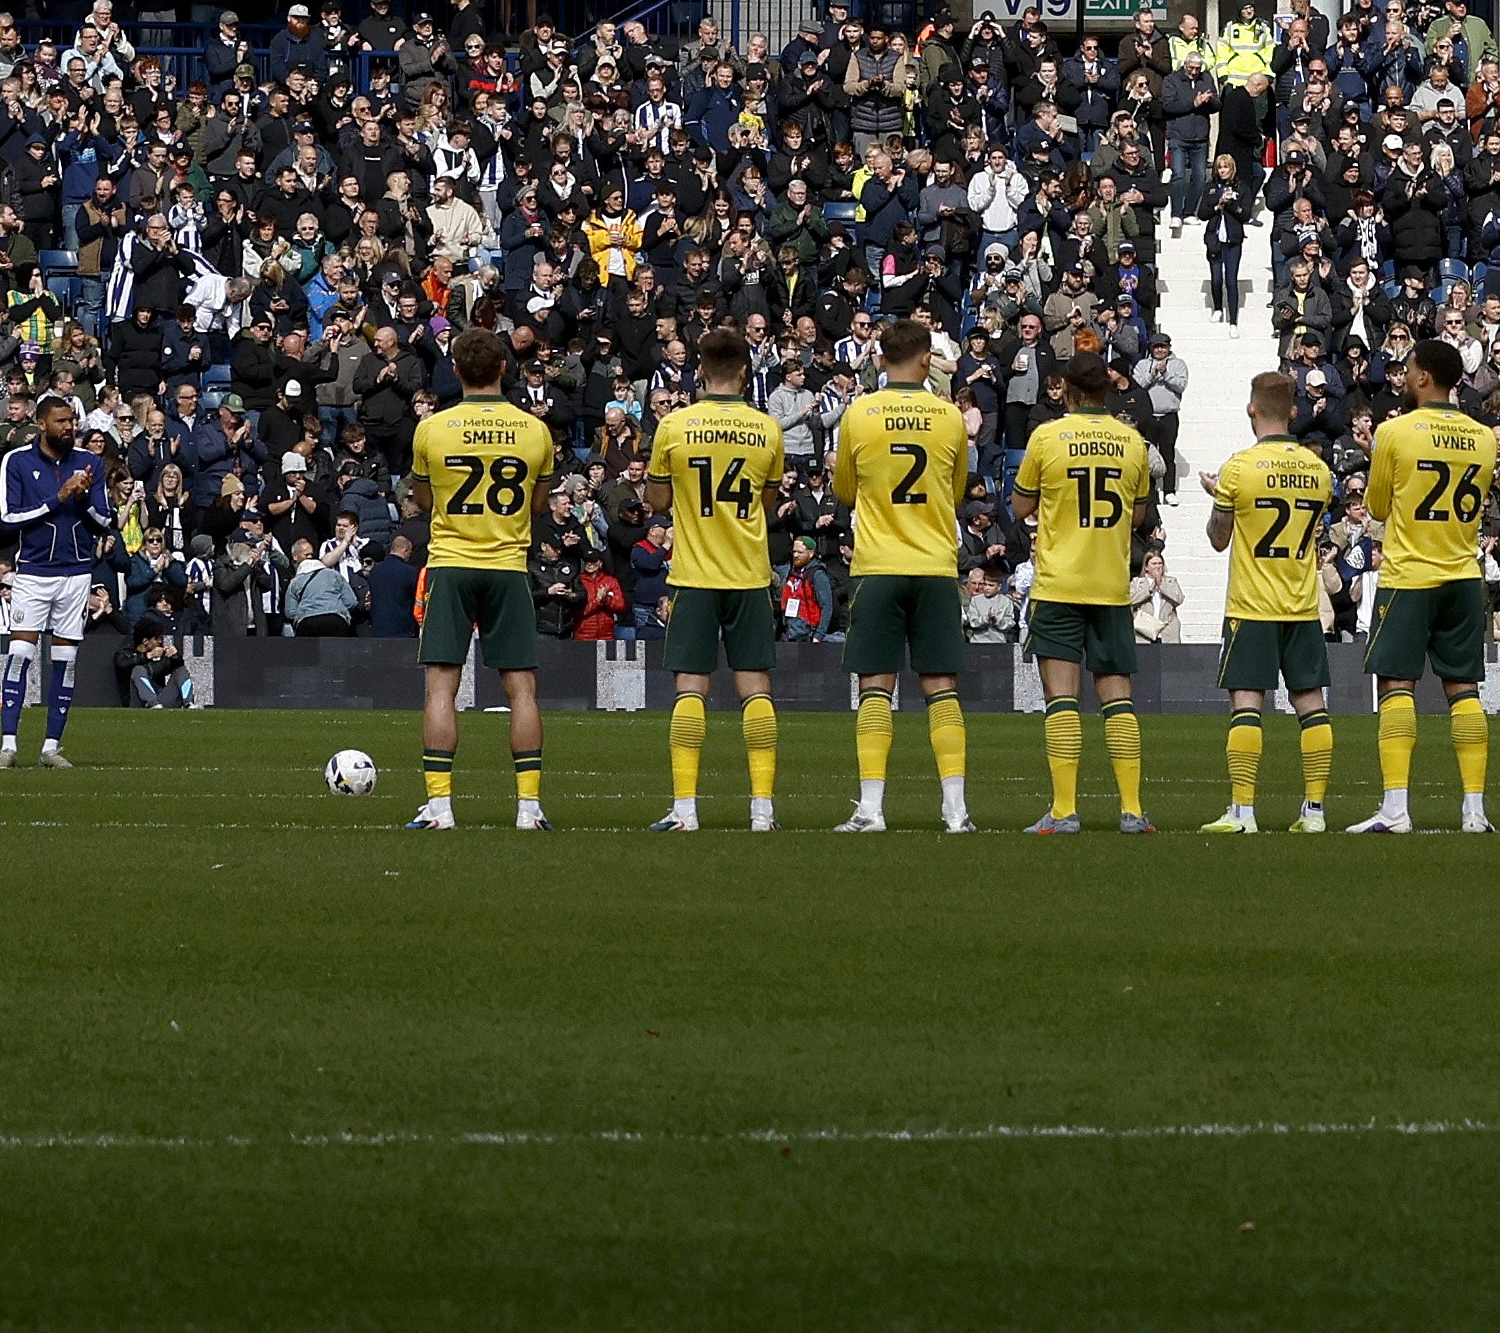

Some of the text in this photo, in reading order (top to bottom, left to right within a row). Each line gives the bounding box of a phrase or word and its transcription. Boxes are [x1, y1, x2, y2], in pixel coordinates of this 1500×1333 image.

[883, 404, 947, 416] Meta Quest
[463, 418, 529, 429] Meta Quest
[702, 418, 764, 430] Meta Quest
[885, 417, 932, 431] DOYLE
[463, 430, 516, 445] SMITH
[684, 430, 767, 448] THOMASON
[1075, 430, 1131, 443] Meta Quest
[1432, 435, 1477, 452] VYNER
[1069, 442, 1125, 458] DOBSON
[890, 443, 927, 504] 2
[1271, 460, 1323, 471] Meta Quest
[445, 455, 528, 516] 28
[688, 456, 754, 519] 14
[1266, 473, 1319, 489] O'BRIEN
[1067, 466, 1123, 528] 15
[1414, 460, 1482, 523] 26
[1254, 497, 1325, 560] 27
